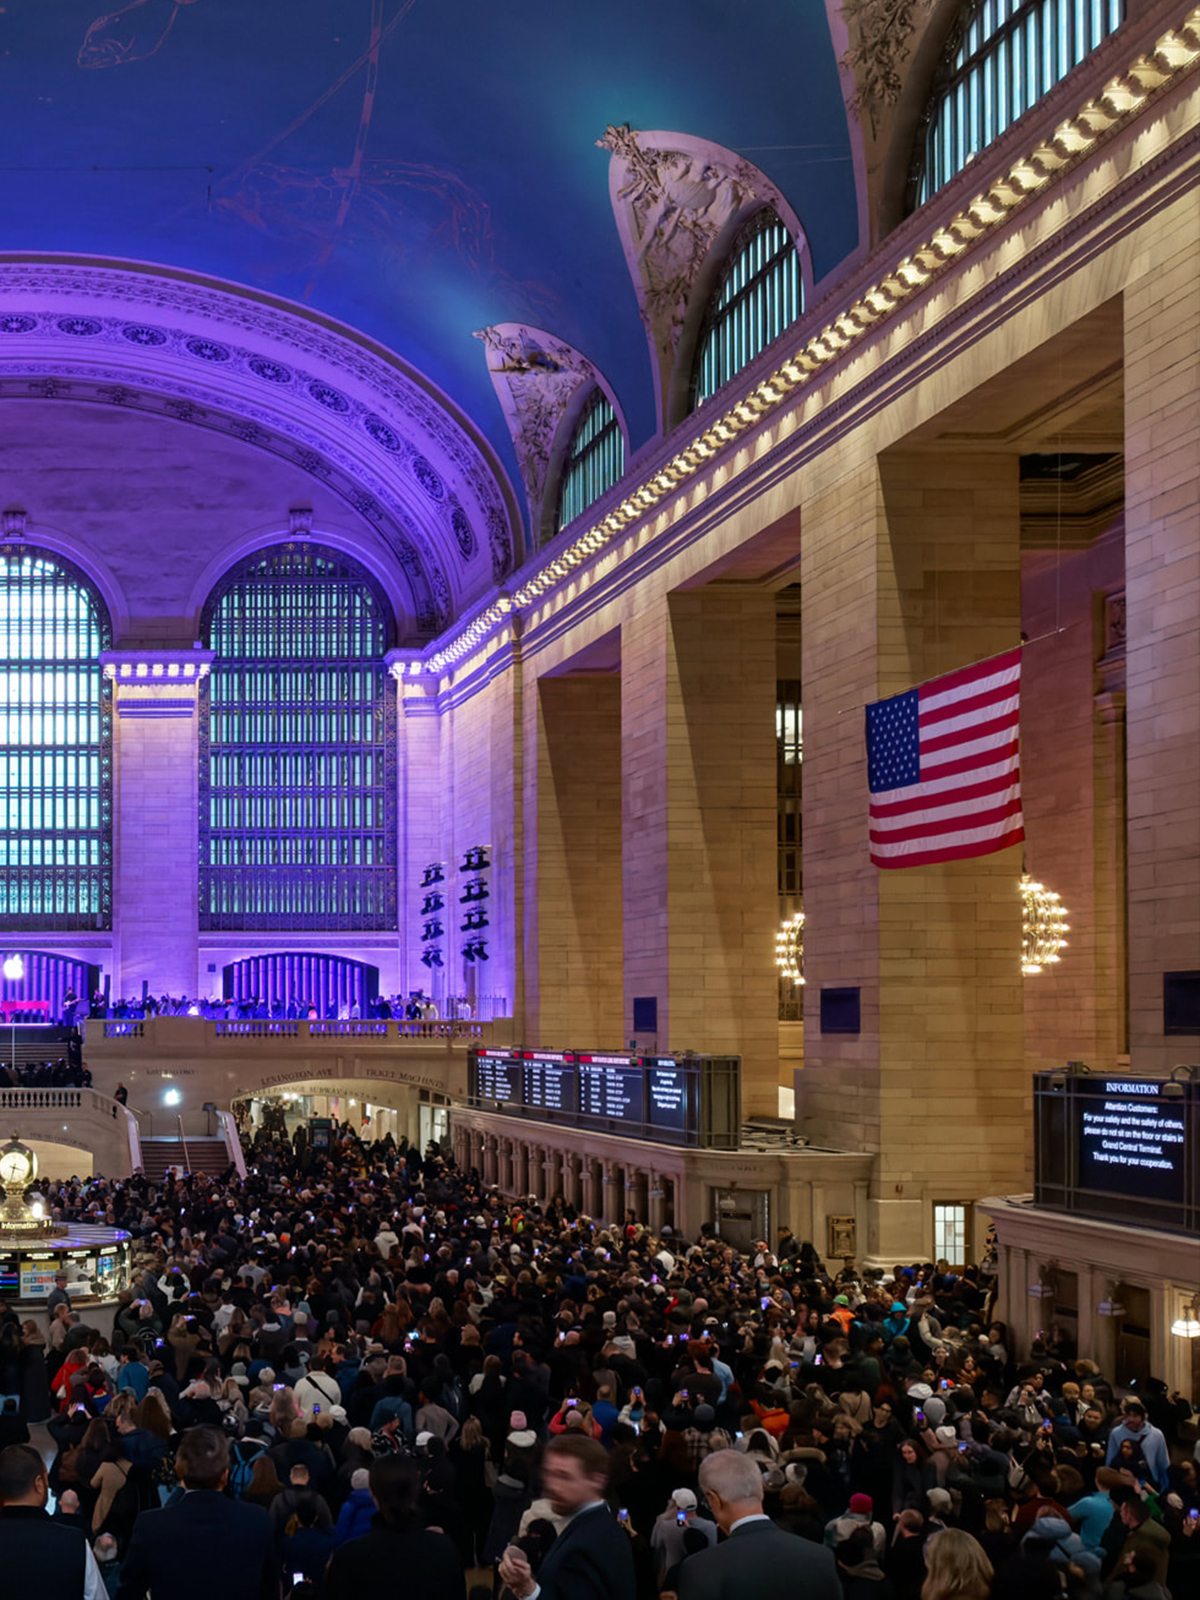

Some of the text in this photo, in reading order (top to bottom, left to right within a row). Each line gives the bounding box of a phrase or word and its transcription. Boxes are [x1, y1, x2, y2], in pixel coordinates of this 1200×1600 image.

[261, 1070, 315, 1085] LEXINGTON
[366, 1069, 395, 1078] TICKET
[1106, 1082, 1159, 1095] INFORMATION
[1104, 1101, 1127, 1111] Attention
[1083, 1112, 1184, 1130] For your safety and the safety of others,
[1084, 1126, 1101, 1135] please
[1101, 1127, 1108, 1136] do
[1109, 1128, 1117, 1137] not
[1132, 1130, 1141, 1139] the
[1142, 1131, 1154, 1140] floor
[1154, 1133, 1161, 1141] or
[1161, 1133, 1176, 1142] stairs
[1102, 1140, 1118, 1150] Grand
[1119, 1142, 1138, 1152] Central
[1093, 1151, 1109, 1161] Thank
[1109, 1155, 1119, 1163] you
[1119, 1155, 1127, 1163] for
[1127, 1158, 1139, 1166] your
[1, 1221, 39, 1230] Information
